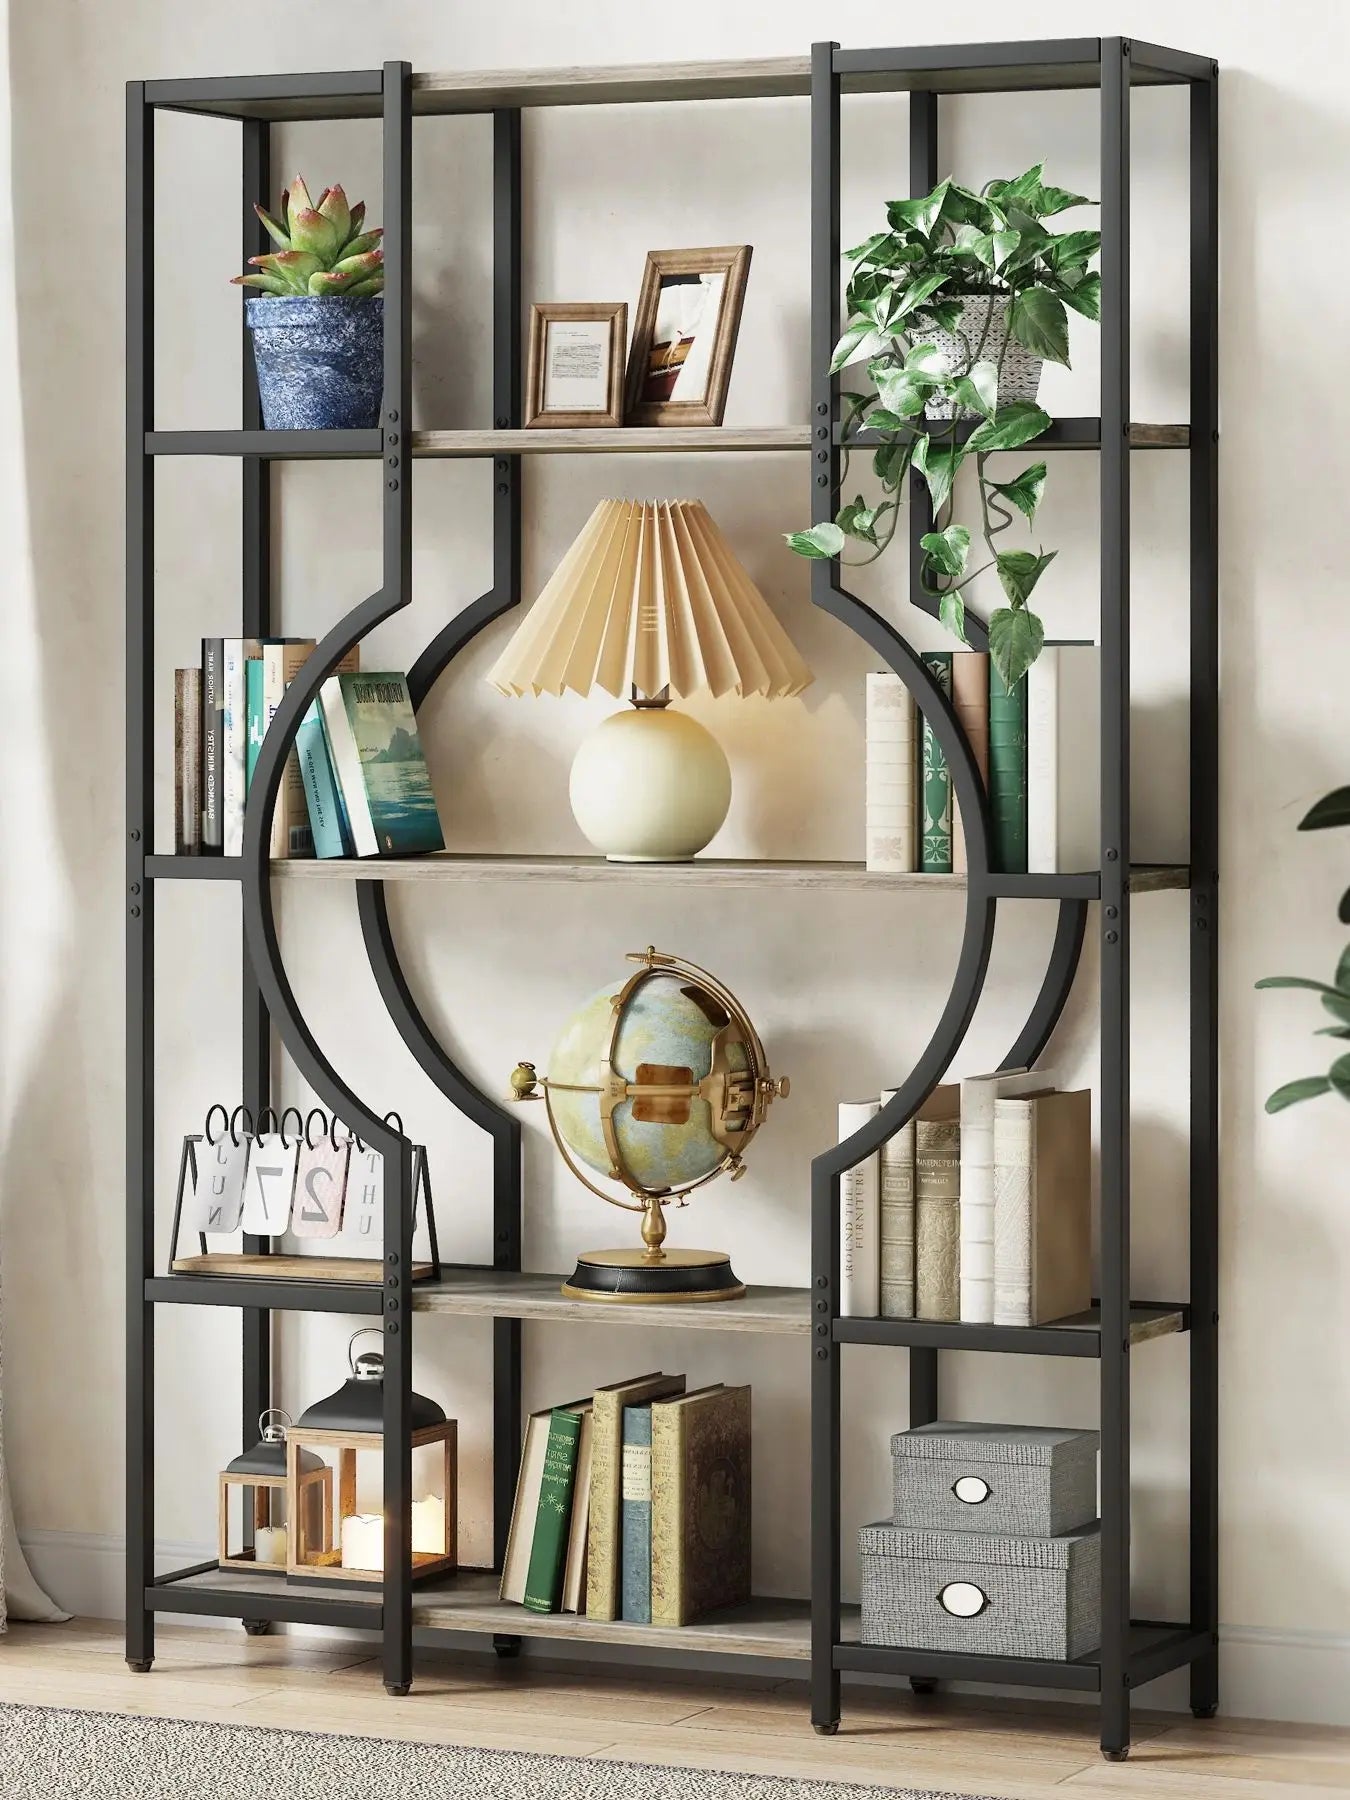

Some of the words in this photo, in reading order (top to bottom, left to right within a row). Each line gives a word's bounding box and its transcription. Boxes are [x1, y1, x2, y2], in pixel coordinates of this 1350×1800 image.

[845, 1188, 854, 1215] THE
[855, 1168, 864, 1249] FURNITURE
[844, 1222, 854, 1281] AROUND
